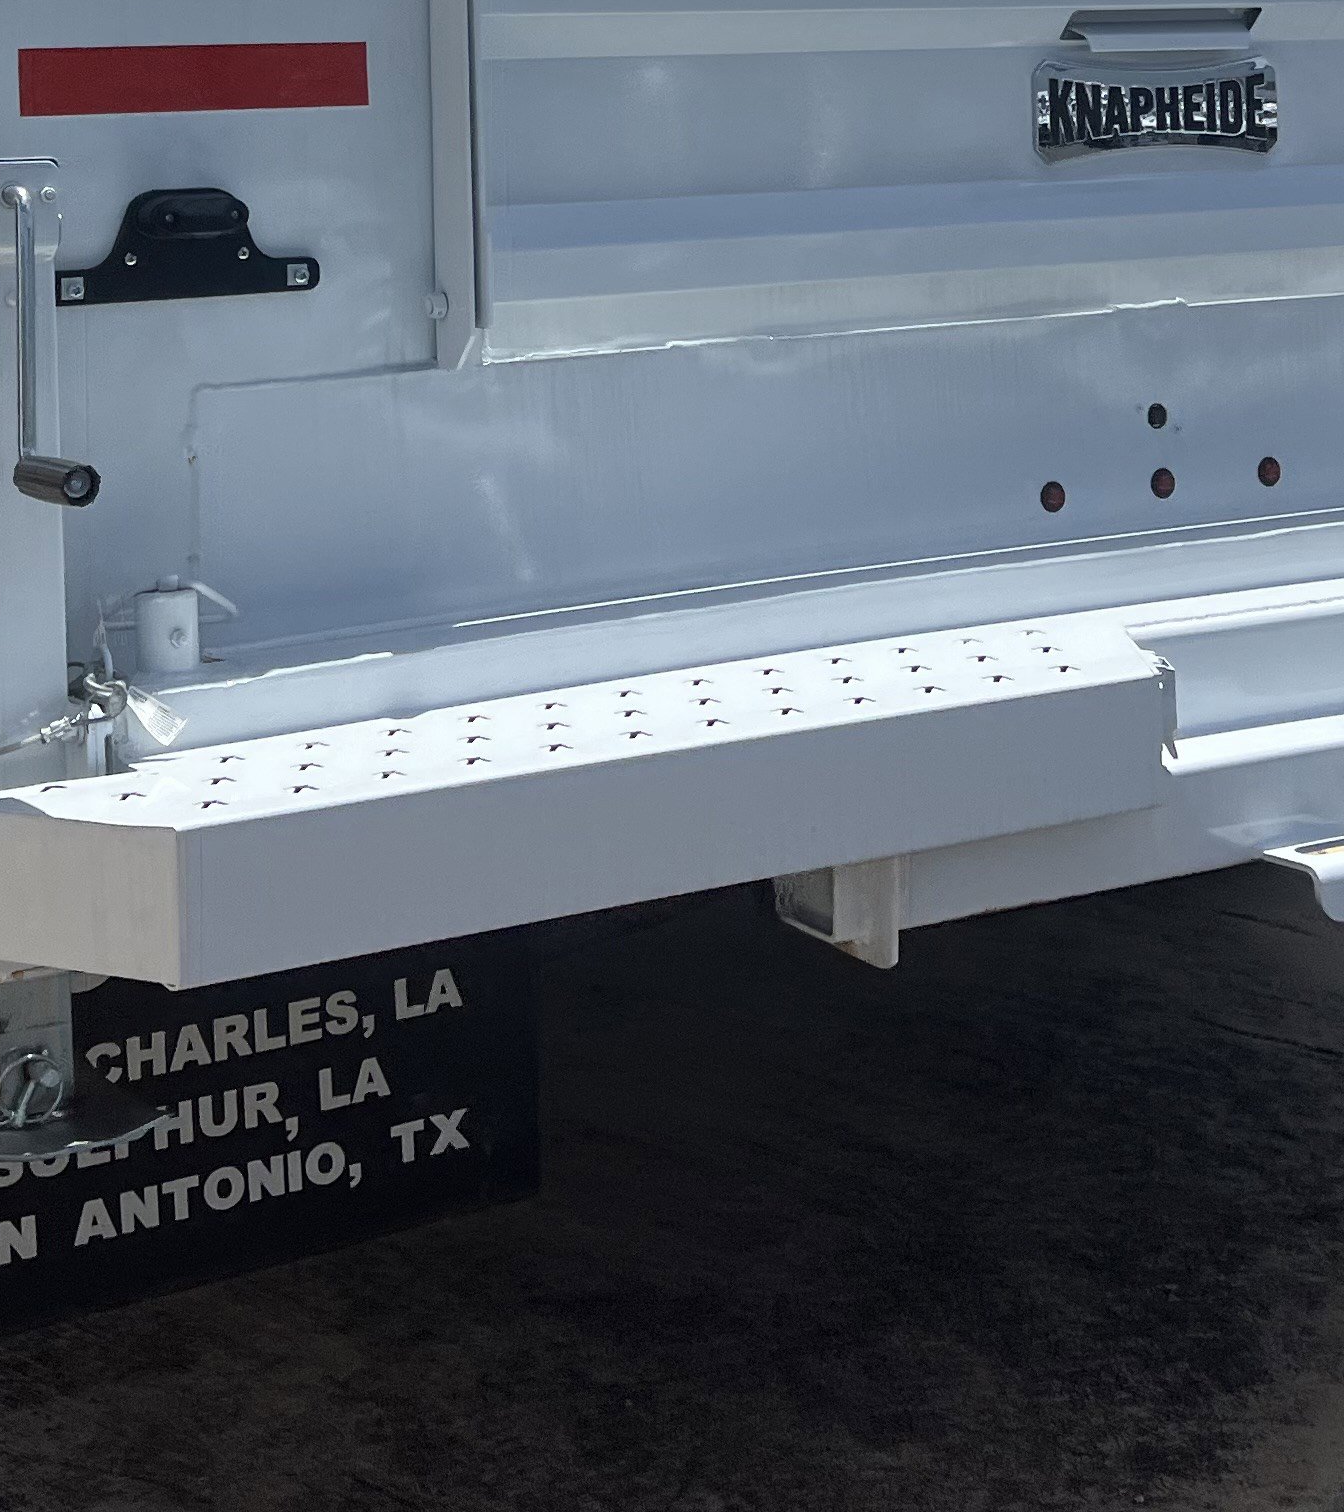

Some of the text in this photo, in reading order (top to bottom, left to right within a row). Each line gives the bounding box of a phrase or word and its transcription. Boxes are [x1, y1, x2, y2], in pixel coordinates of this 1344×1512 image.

[1049, 73, 1270, 144] KNAPHEIDE
[86, 968, 463, 1083] CHARLES, LA
[318, 1057, 391, 1111] LA
[74, 1142, 362, 1247] ANTONIO,
[390, 1108, 470, 1163] TX
